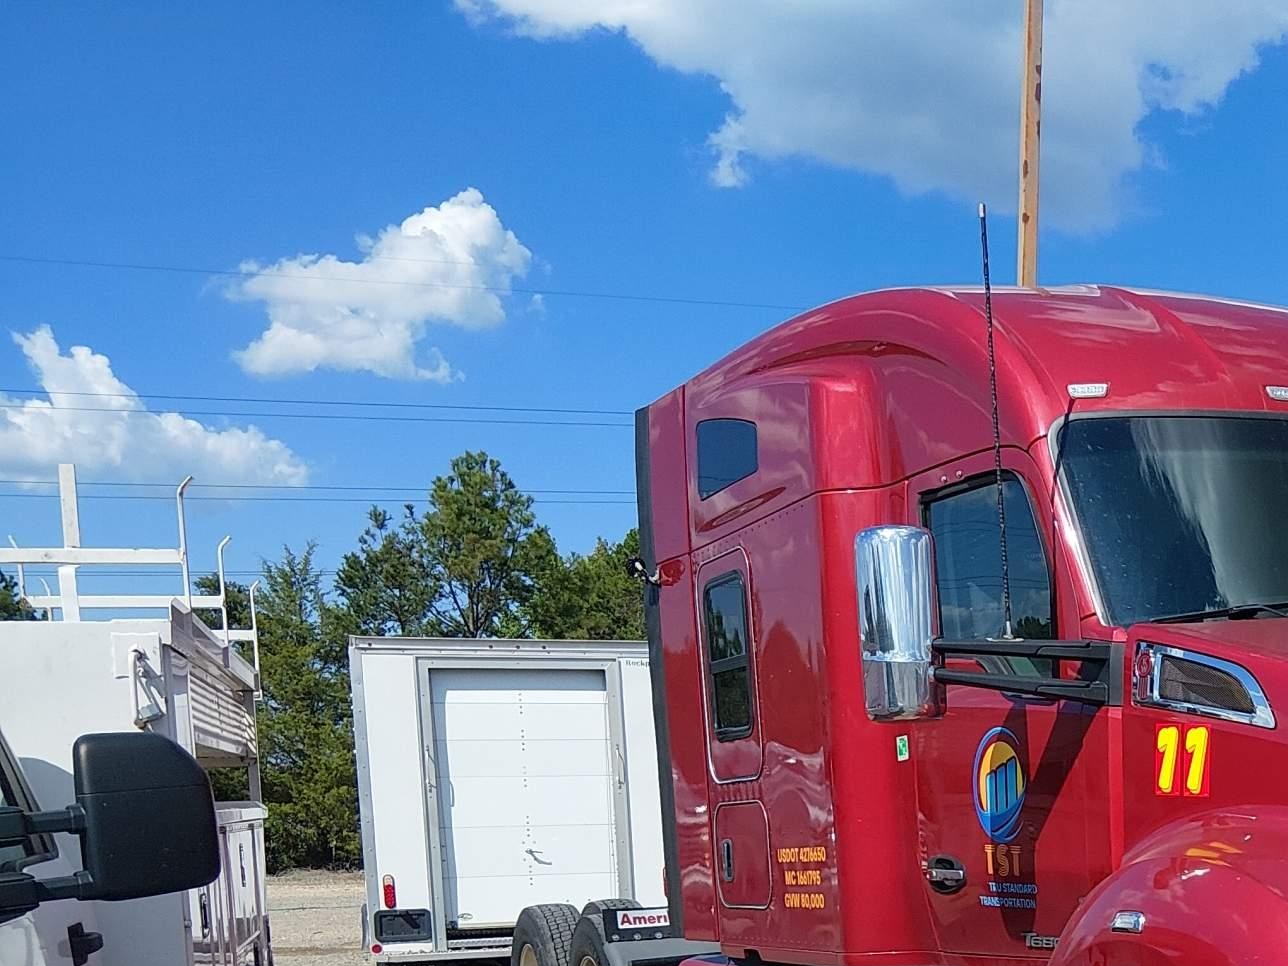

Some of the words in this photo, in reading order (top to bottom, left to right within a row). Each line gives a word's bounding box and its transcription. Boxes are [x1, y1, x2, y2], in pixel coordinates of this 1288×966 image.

[1157, 726, 1208, 793] 11
[777, 847, 799, 863] USDOT
[799, 846, 826, 863] 4276650
[984, 844, 1022, 877] TST
[784, 870, 796, 886] MC
[796, 870, 821, 886] 1661795
[1003, 883, 1038, 895] STANDARD
[784, 893, 800, 908] GVW
[801, 893, 825, 910] 80,000
[979, 895, 1036, 909] TRANSPORTATION
